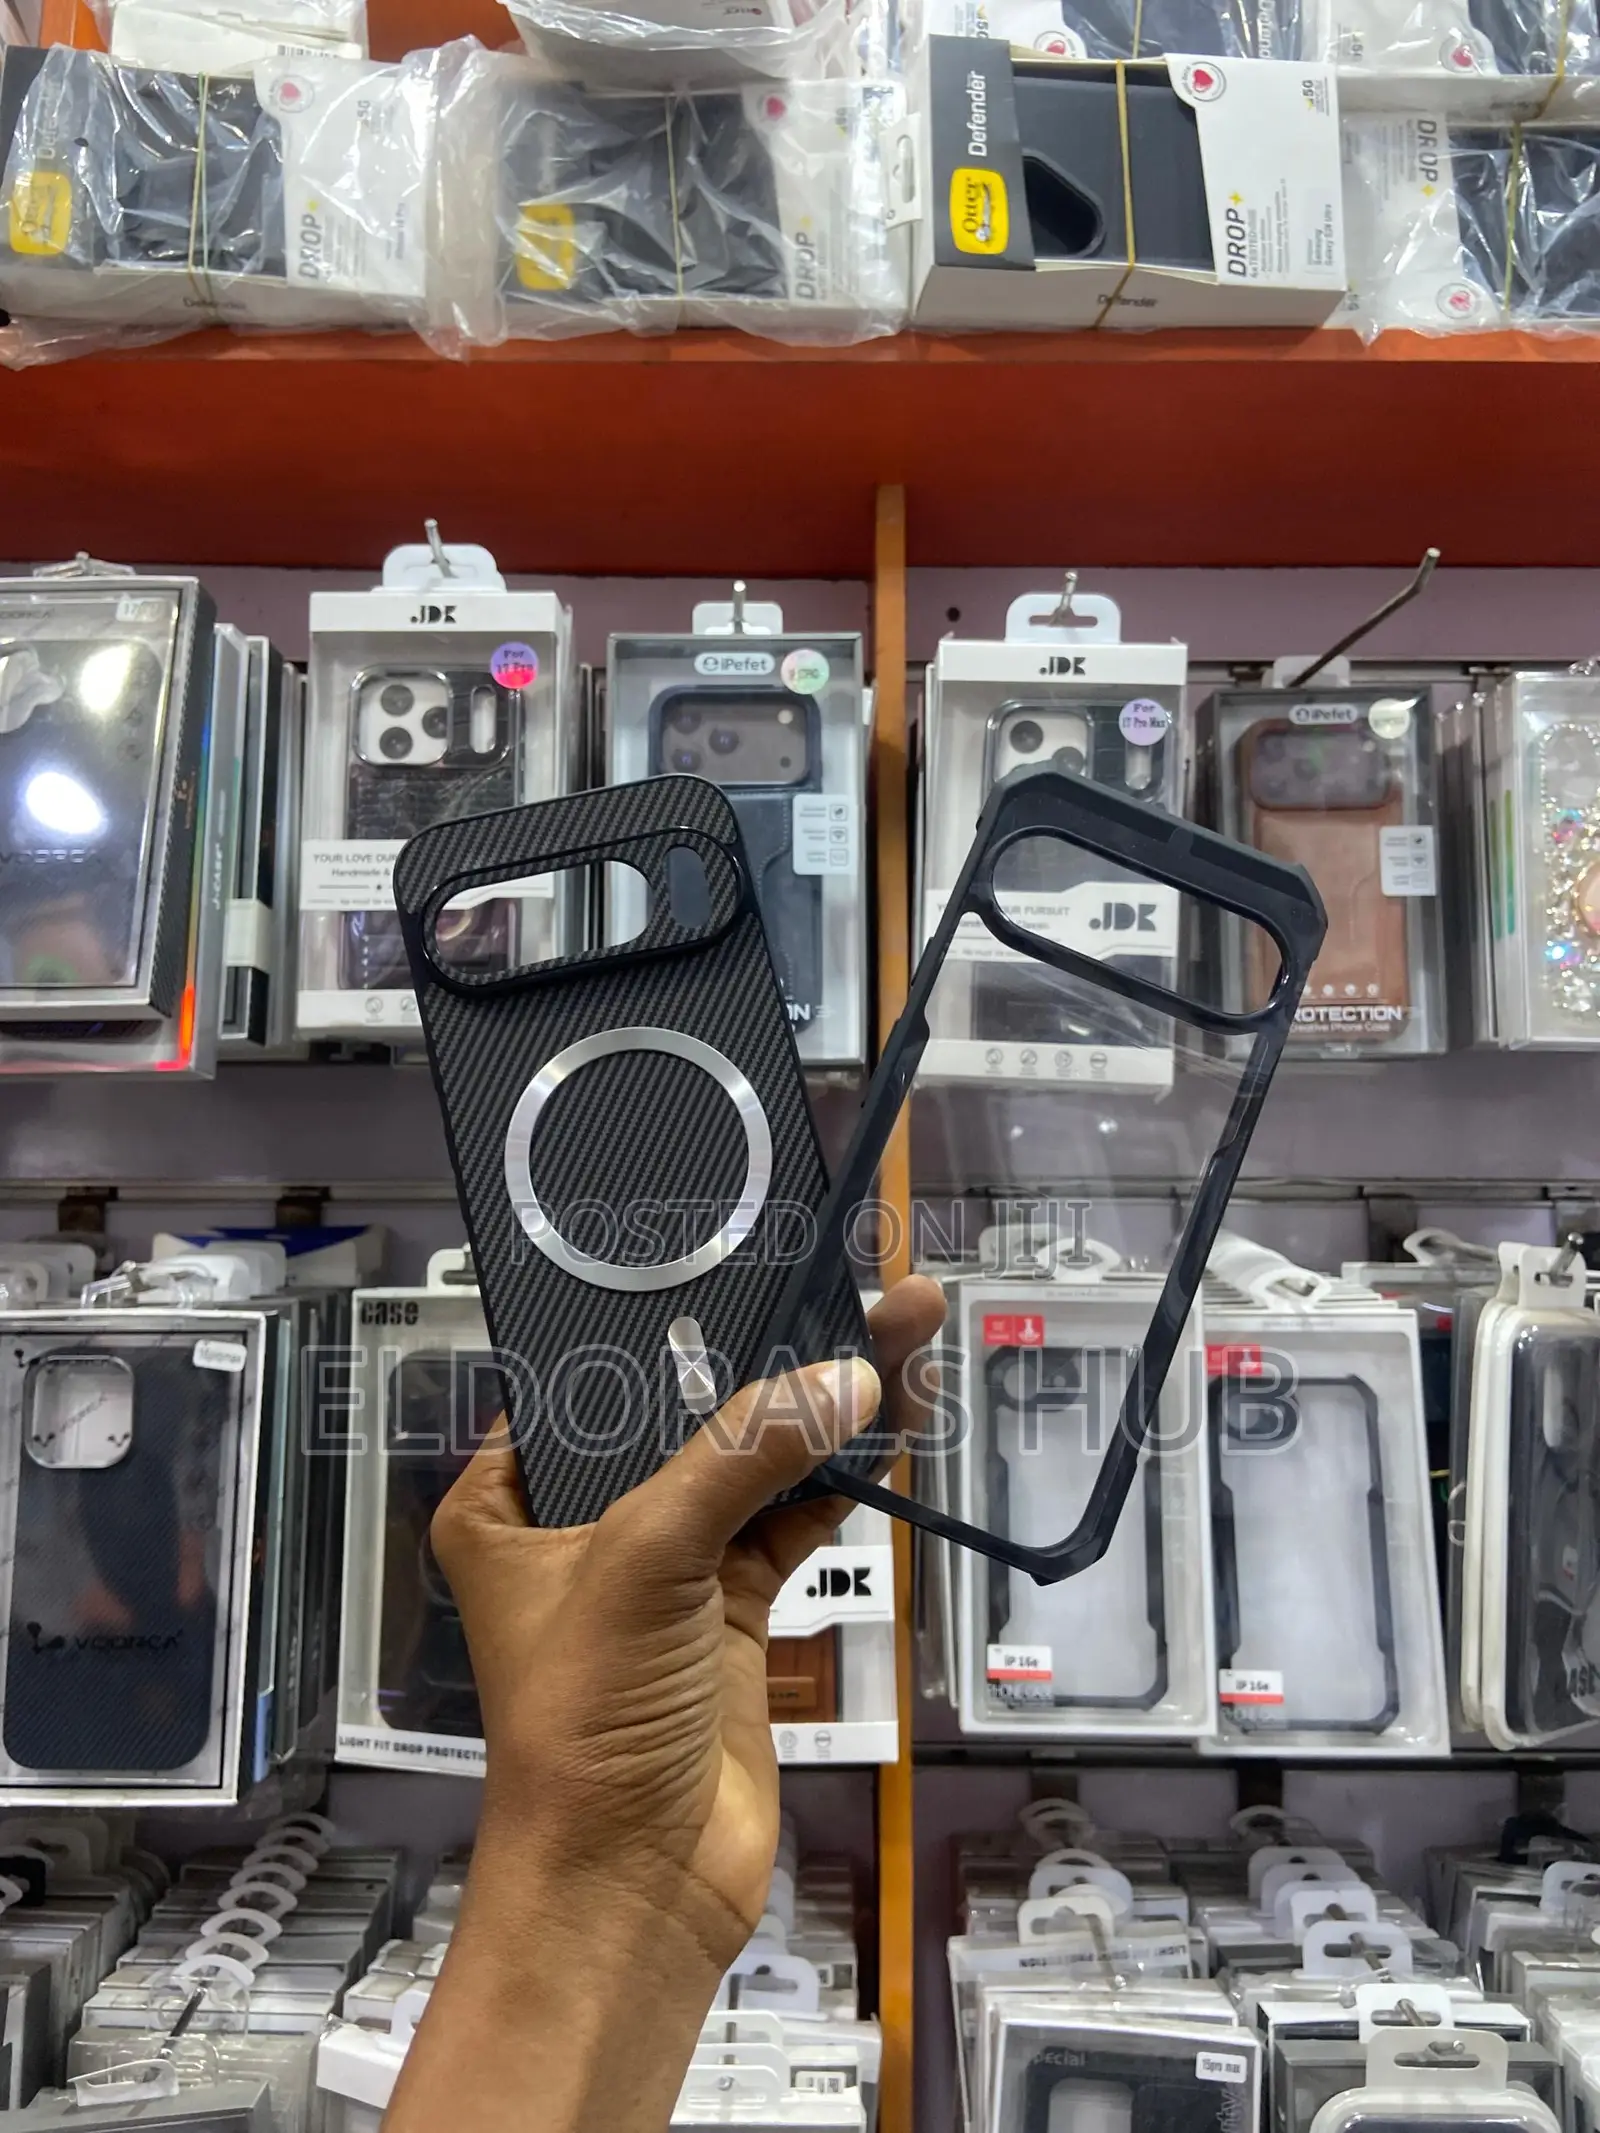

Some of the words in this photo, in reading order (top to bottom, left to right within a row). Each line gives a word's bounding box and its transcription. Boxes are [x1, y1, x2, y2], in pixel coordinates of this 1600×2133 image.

[967, 70, 987, 157] Defender
[1132, 703, 1156, 713] For
[345, 854, 372, 863] LOVE
[1293, 1005, 1402, 1022] ROTECTION
[339, 1735, 371, 1750] LIGHT
[375, 1739, 390, 1751] FIT
[393, 1741, 424, 1755] DROP
